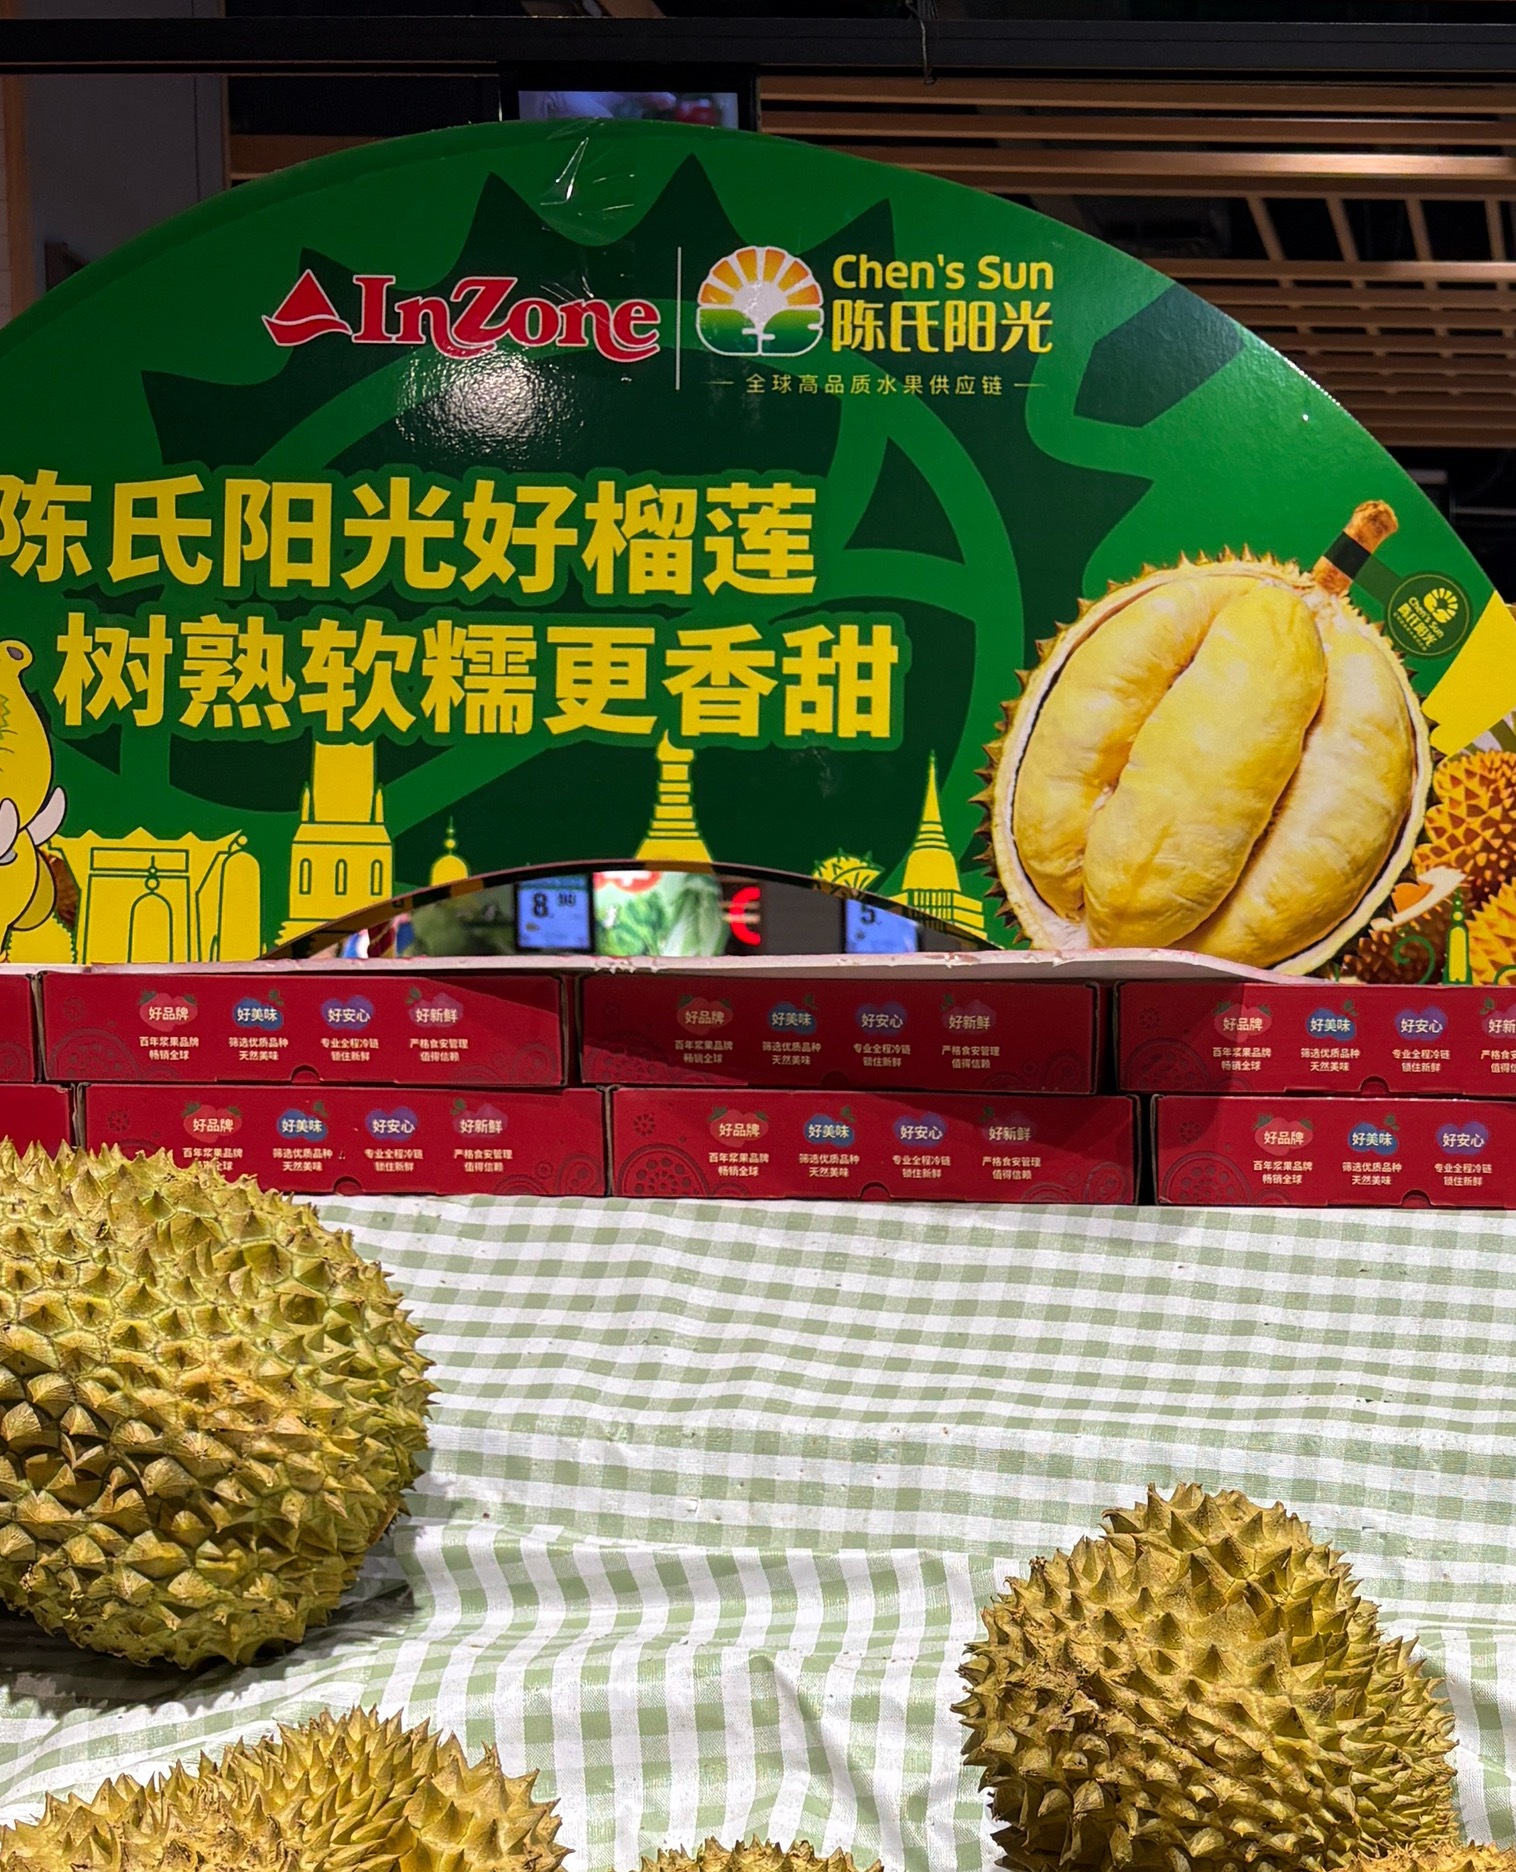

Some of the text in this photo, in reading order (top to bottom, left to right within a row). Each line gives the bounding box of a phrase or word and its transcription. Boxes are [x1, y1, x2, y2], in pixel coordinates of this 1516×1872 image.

[834, 255, 1054, 290] Chen's Sun
[352, 275, 661, 362] InZone
[832, 299, 1055, 355] 陈氏阳光
[745, 373, 1004, 395] 全球高品质水果供应链
[0, 470, 818, 596] 陈氏阳光好榴莲
[54, 612, 901, 739] 树熟软糯更香甜
[149, 1007, 188, 1020] 好品牌
[238, 1008, 277, 1022] 好美味
[328, 1009, 370, 1022] 好安心
[416, 1009, 457, 1023] 好新鲜
[686, 1011, 724, 1024] 好品牌
[772, 1013, 811, 1026] 好美味
[862, 1014, 903, 1028] 好安心
[949, 1015, 990, 1030] 好新鲜
[1224, 1018, 1262, 1031] 好品牌
[1311, 1019, 1350, 1032] 好美味
[1401, 1019, 1442, 1034] 好安心
[240, 1051, 278, 1060] 天然美味
[1311, 1062, 1349, 1071] 天然美味
[193, 1119, 233, 1132] 好品牌
[282, 1119, 322, 1133] 好美味
[373, 1119, 415, 1134] 好安心
[460, 1119, 502, 1134] 好新鲜
[720, 1123, 759, 1137] 好品牌
[809, 1125, 849, 1138] 好美味
[901, 1126, 942, 1140] 好安心
[989, 1127, 1030, 1141] 好新鲜
[1264, 1132, 1303, 1144] 好品牌
[1353, 1133, 1392, 1146] 好美味
[1443, 1133, 1484, 1147] 好安心
[284, 1162, 322, 1171] 天然美味
[810, 1167, 848, 1177] 天然美味
[1352, 1176, 1391, 1185] 天然美味
